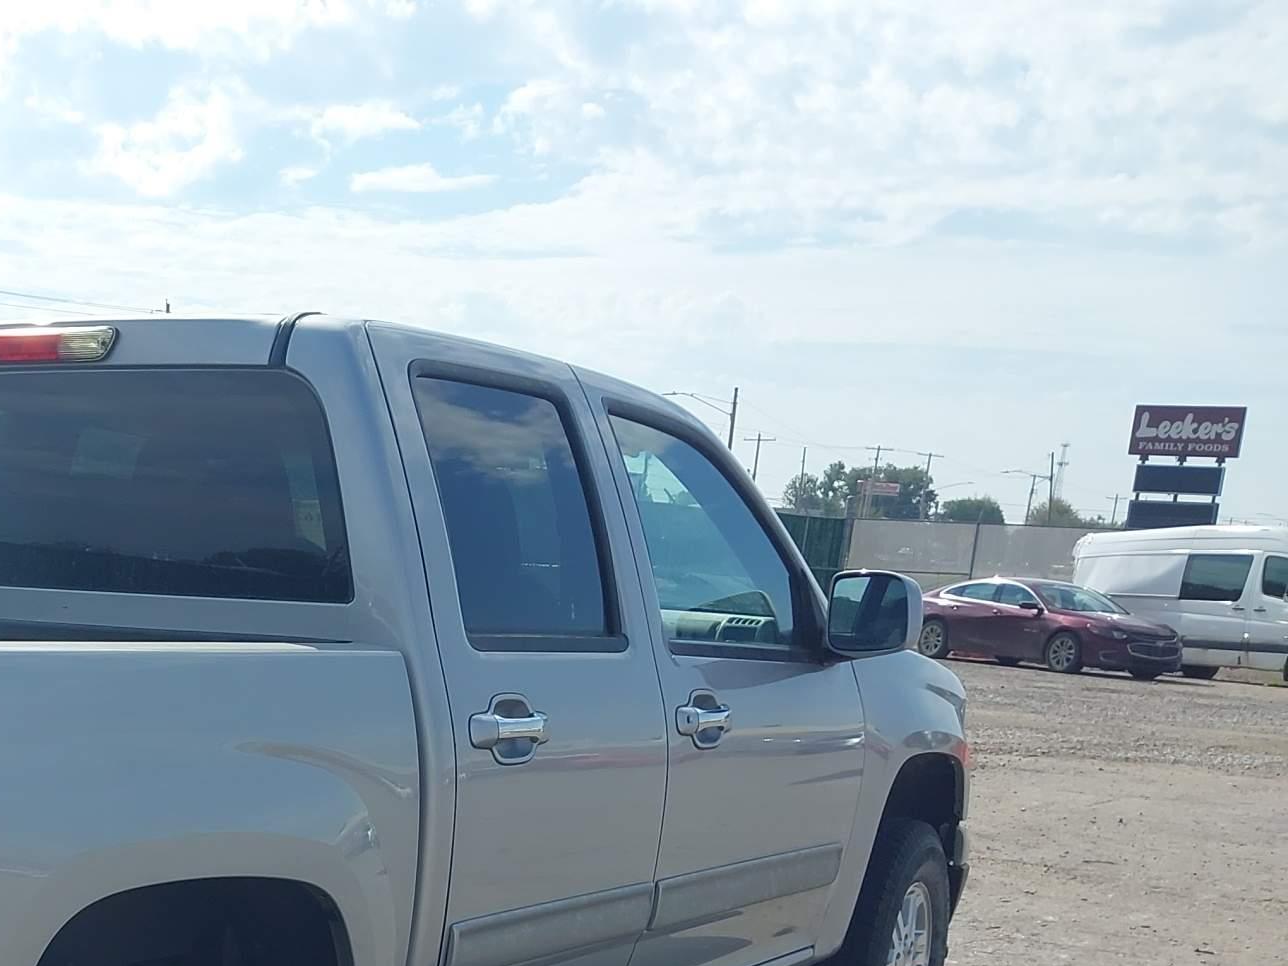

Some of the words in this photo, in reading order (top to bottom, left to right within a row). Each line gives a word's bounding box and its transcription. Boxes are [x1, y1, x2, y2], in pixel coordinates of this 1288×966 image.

[1136, 411, 1239, 441] Leeker's
[1138, 441, 1184, 452] FAMILY
[1187, 443, 1229, 453] FOODS
